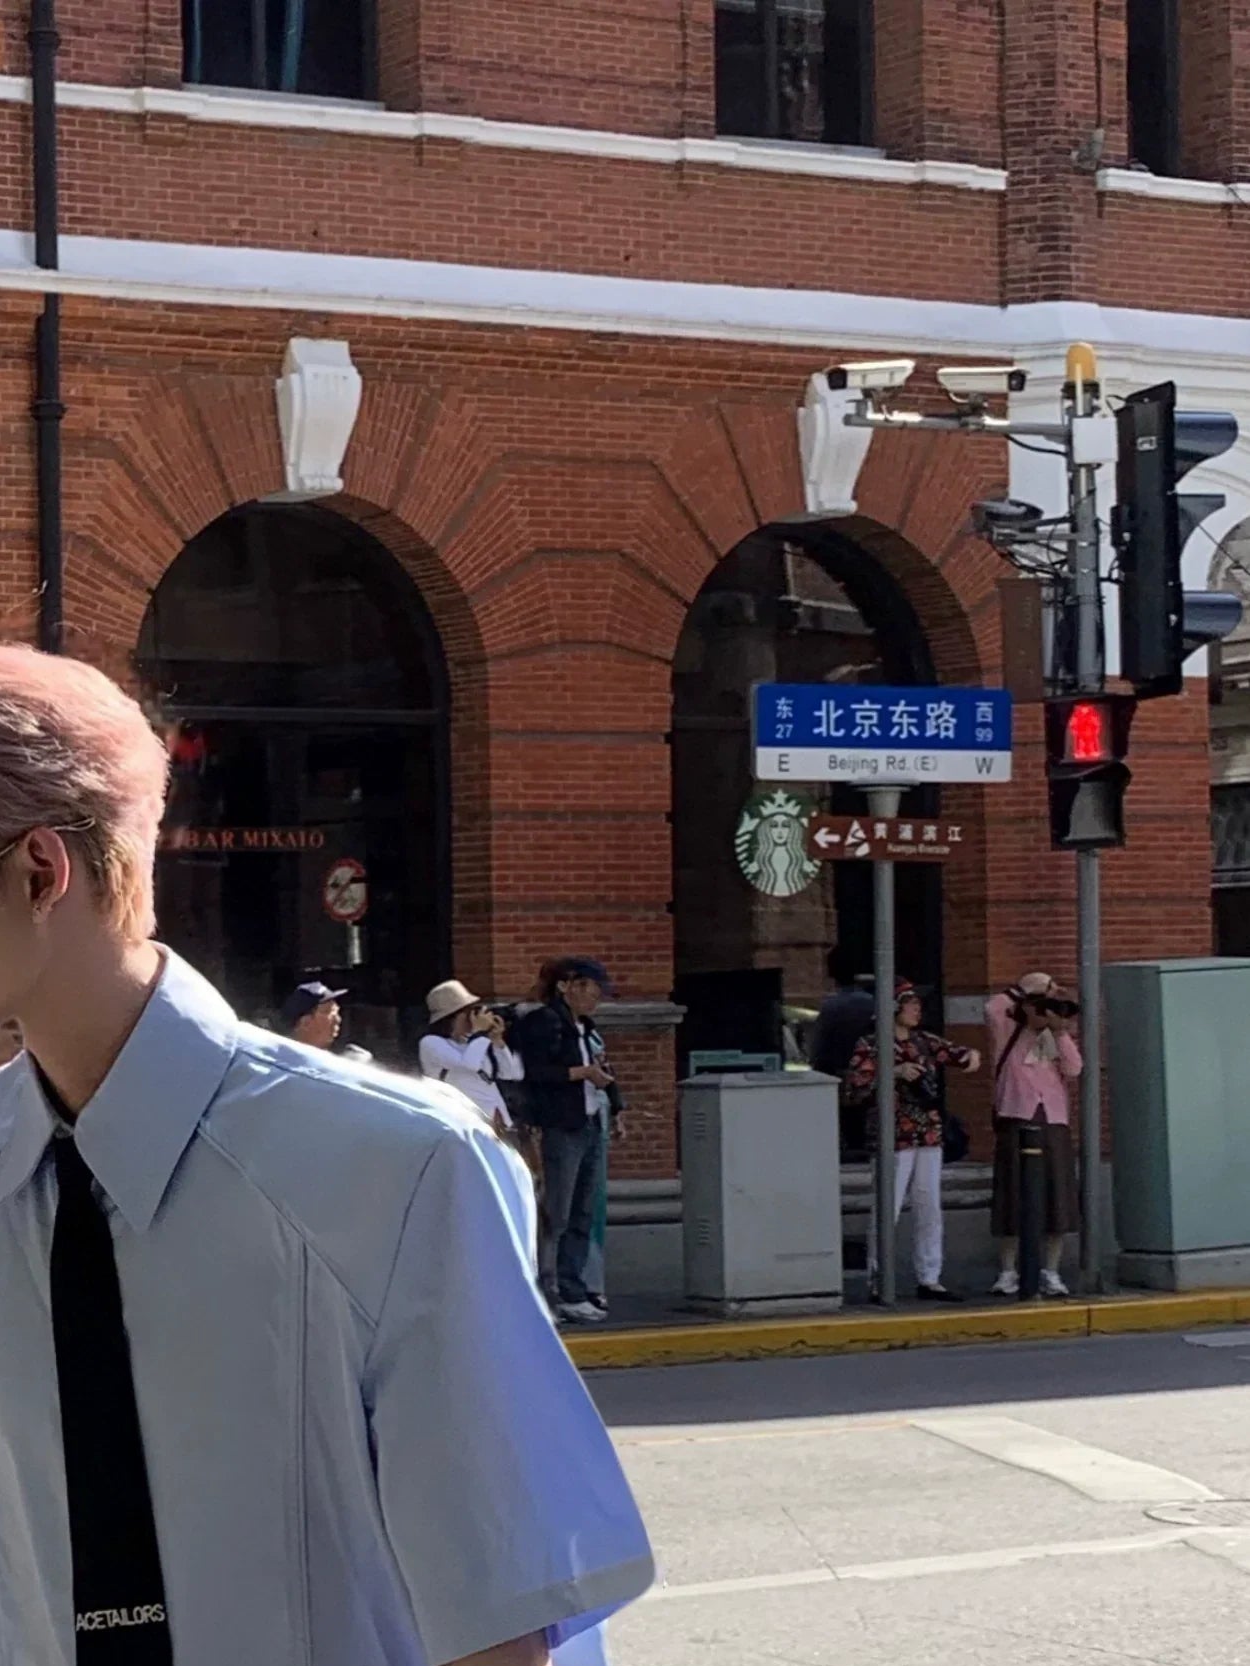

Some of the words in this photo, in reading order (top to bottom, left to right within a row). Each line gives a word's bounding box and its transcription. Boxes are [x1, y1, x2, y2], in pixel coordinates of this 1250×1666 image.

[775, 697, 794, 719] 东
[975, 702, 994, 723] 西
[812, 699, 957, 740] 北京东路
[775, 724, 793, 739] 27
[975, 727, 994, 742] 99
[778, 754, 790, 773] E
[828, 755, 878, 774] Beijing
[975, 757, 994, 774] W
[187, 830, 235, 848] BAR
[75, 1603, 166, 1632] ACETAILORS
